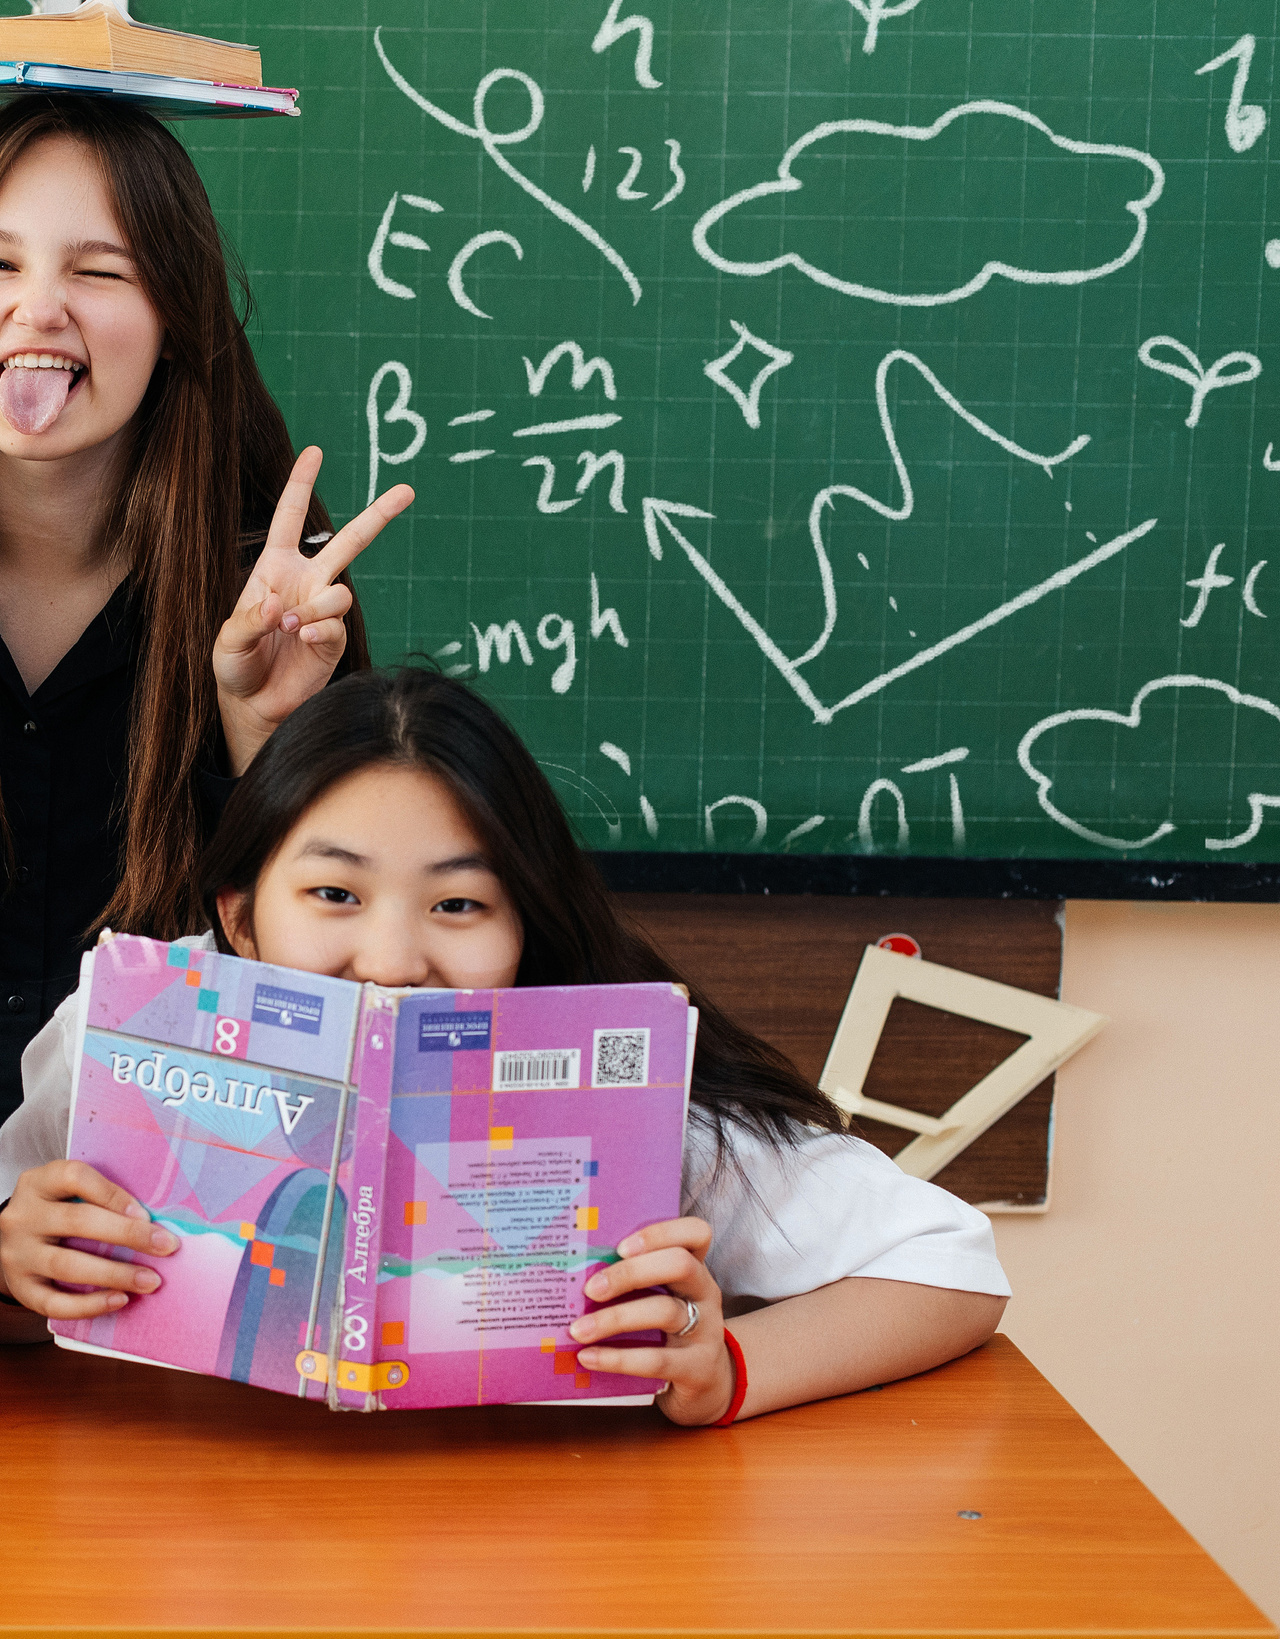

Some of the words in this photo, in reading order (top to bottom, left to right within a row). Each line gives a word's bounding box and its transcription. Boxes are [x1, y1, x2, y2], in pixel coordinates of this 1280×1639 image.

[215, 1016, 240, 1055] 8
[108, 1051, 315, 1136] Алгебра
[347, 1186, 377, 1285] Алгебра
